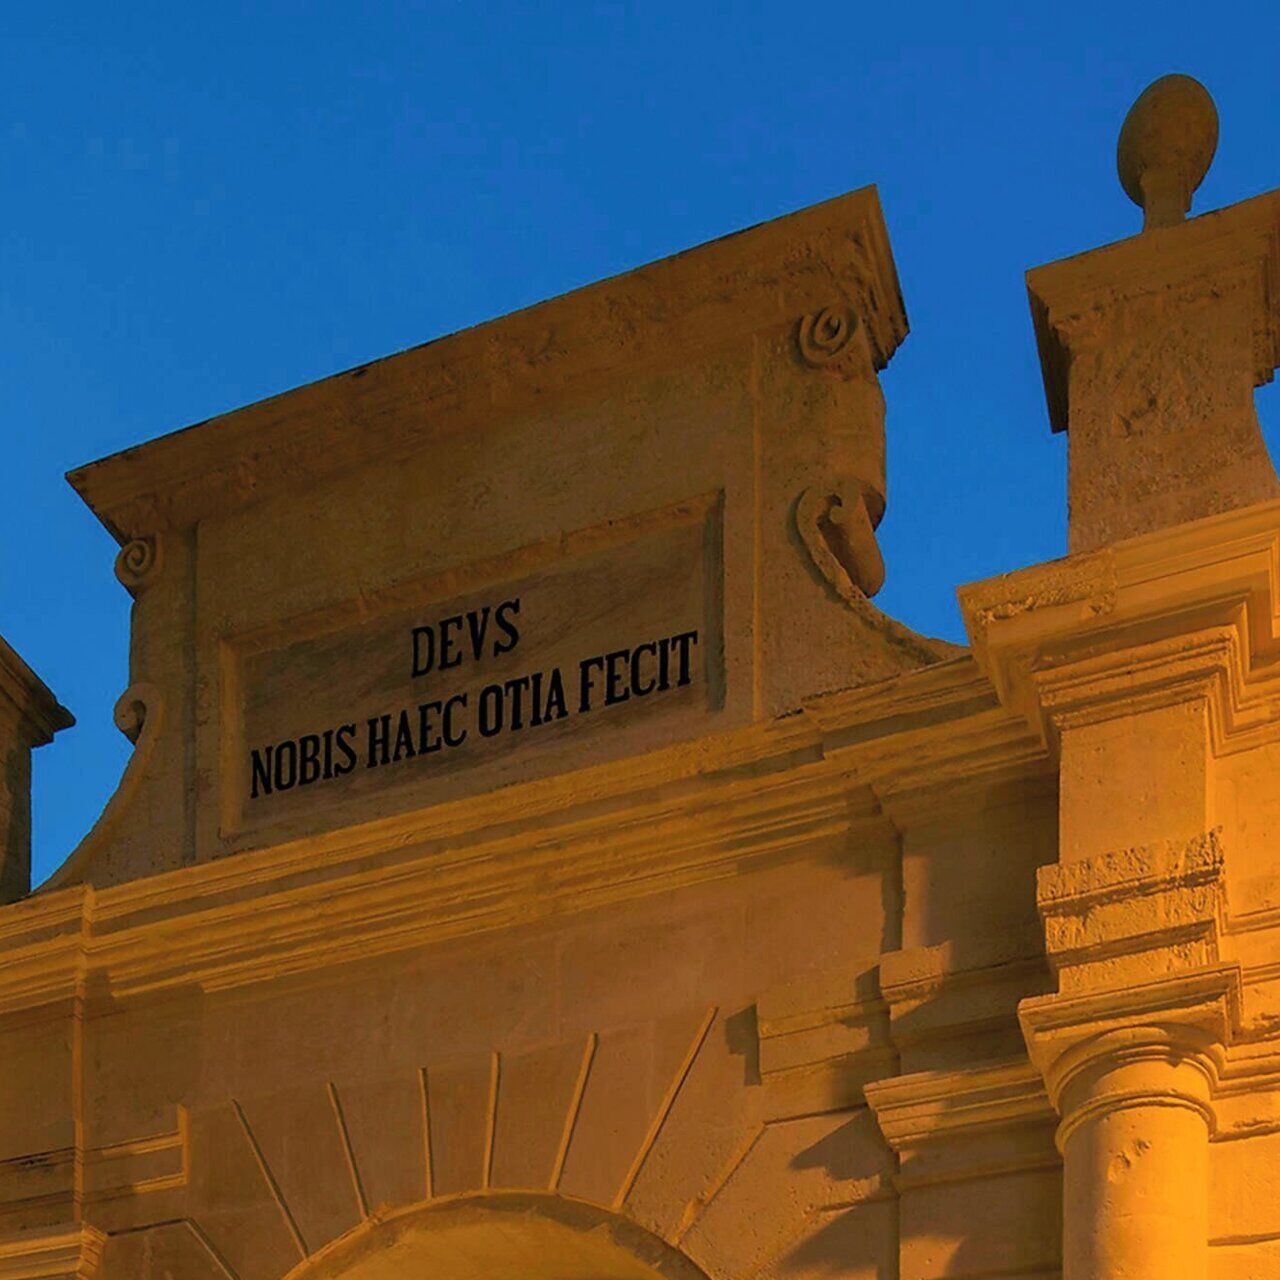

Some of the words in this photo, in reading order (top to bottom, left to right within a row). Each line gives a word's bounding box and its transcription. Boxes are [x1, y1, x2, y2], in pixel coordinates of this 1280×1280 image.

[410, 598, 521, 680] DEVS
[250, 723, 357, 799] NOBIS
[366, 692, 468, 769] HAEC
[478, 668, 569, 738] OTIA
[578, 630, 699, 714] FECIT
